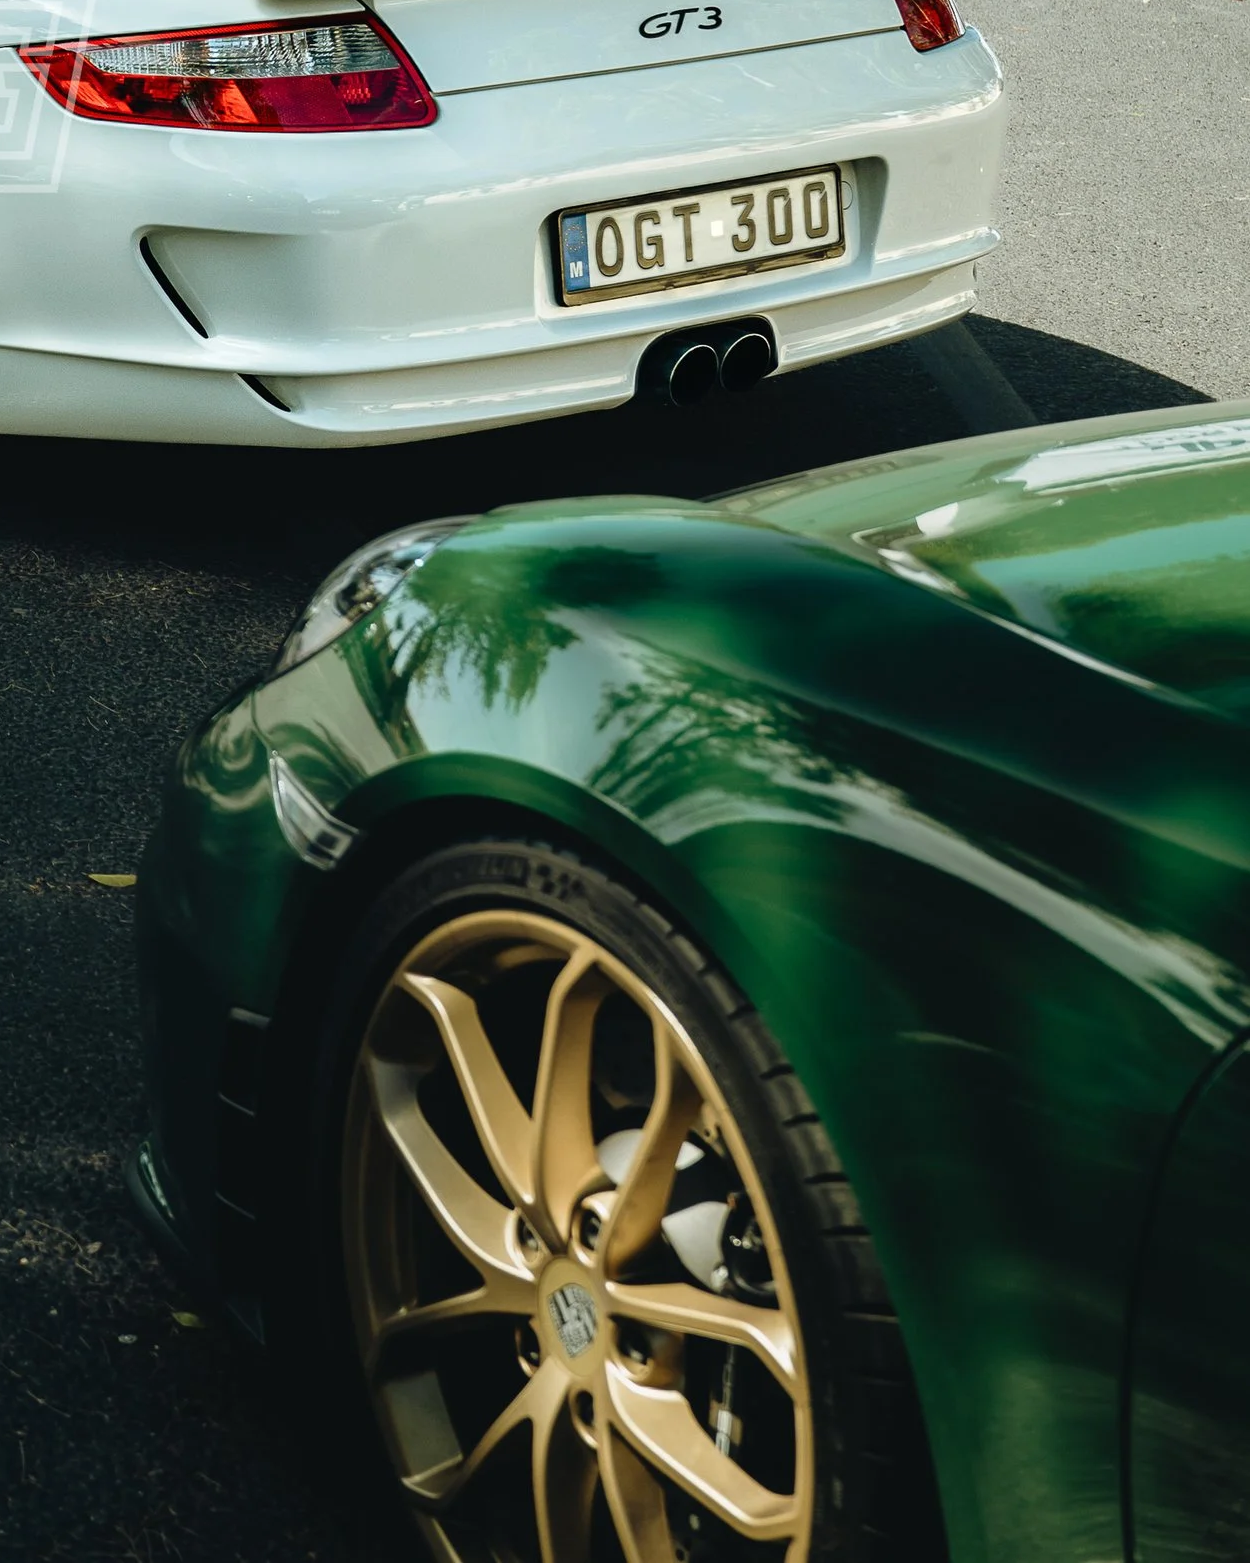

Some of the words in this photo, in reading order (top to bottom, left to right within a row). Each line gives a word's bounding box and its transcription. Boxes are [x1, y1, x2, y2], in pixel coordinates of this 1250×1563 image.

[638, 6, 723, 39] GT3
[594, 202, 700, 278] OGT
[730, 180, 830, 254] 300
[569, 261, 584, 279] M
